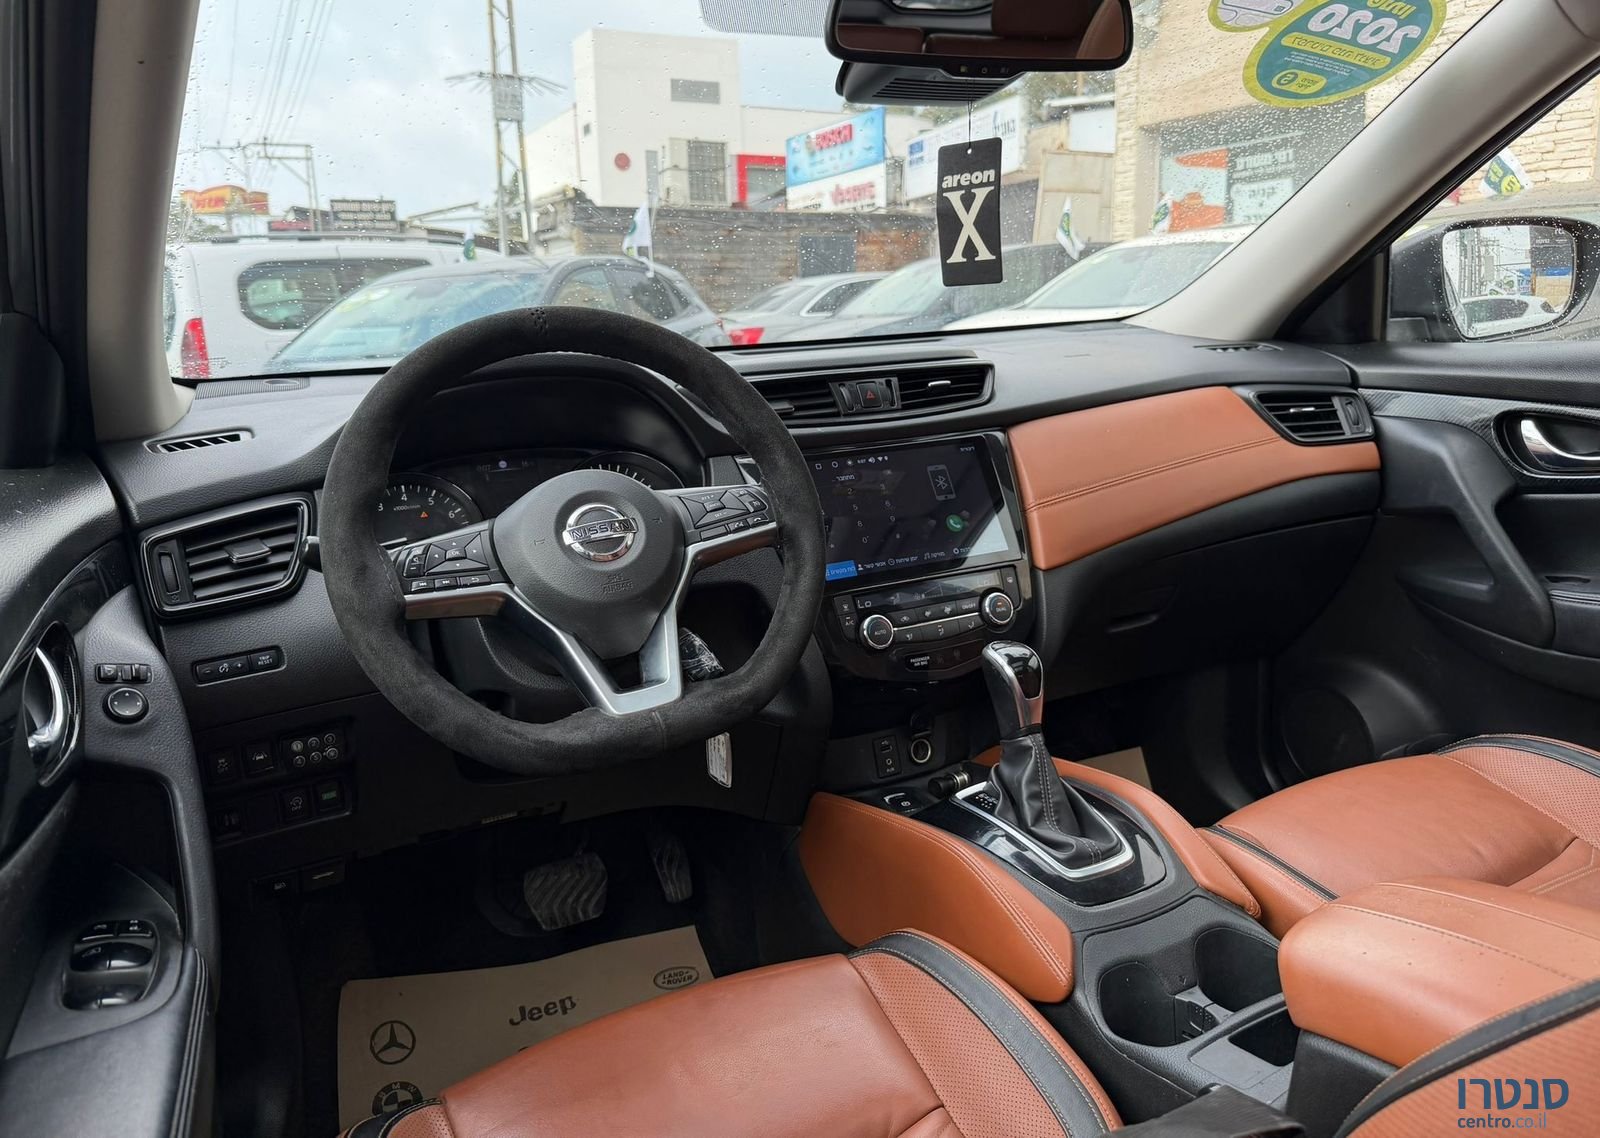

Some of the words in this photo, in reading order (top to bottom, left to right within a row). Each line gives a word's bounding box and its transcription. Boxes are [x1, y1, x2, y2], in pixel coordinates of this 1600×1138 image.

[942, 169, 995, 188] areon
[943, 186, 996, 263] X
[572, 520, 631, 540] NISSAN
[857, 599, 872, 608] Lo
[508, 995, 578, 1026] Jeep
